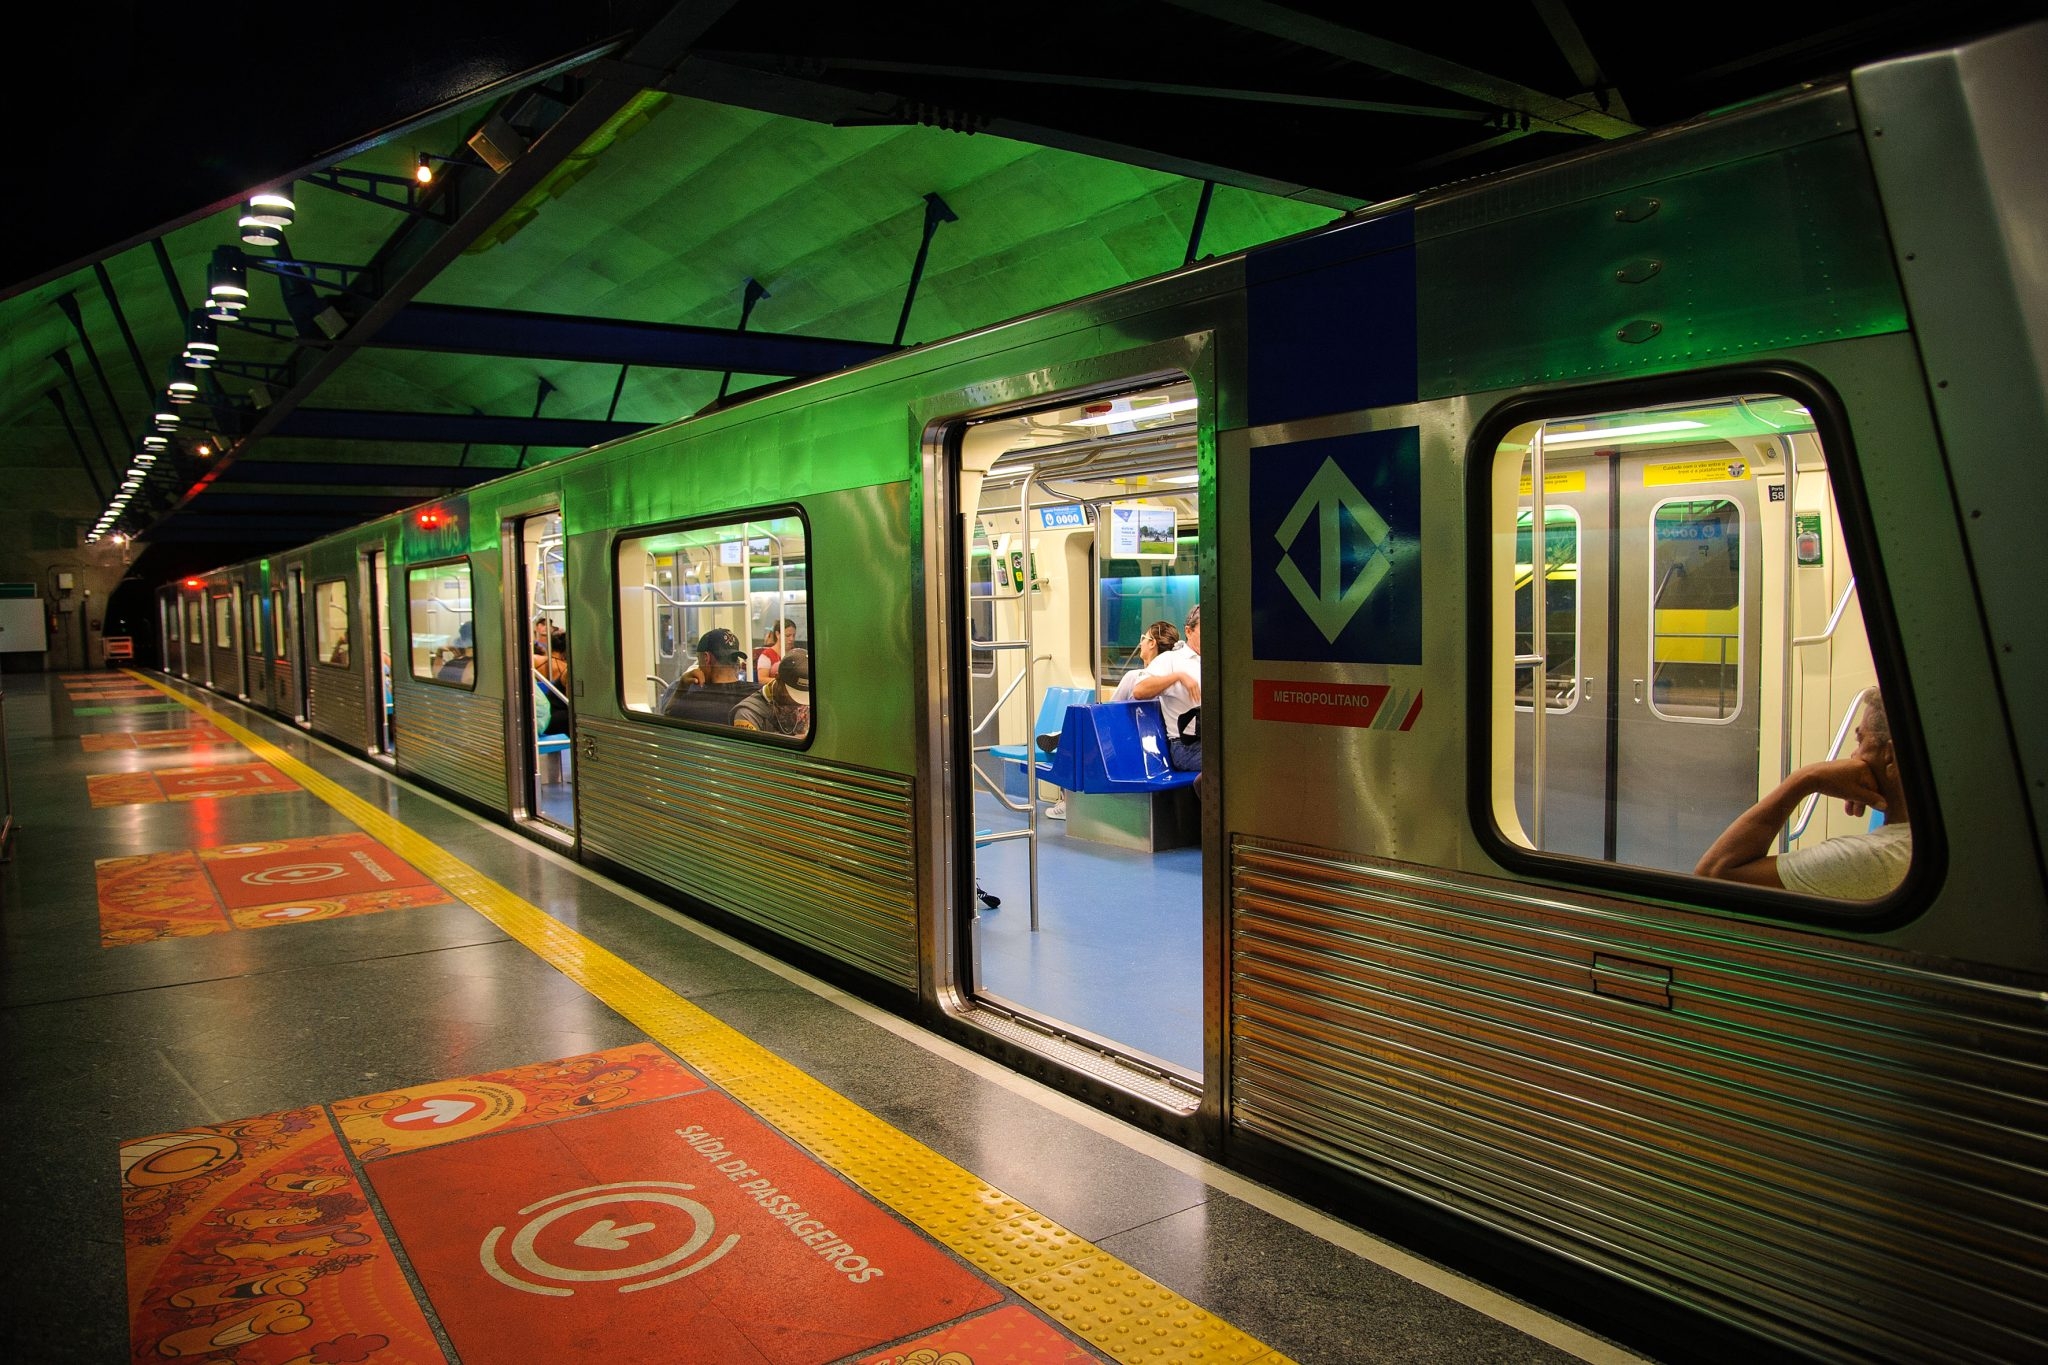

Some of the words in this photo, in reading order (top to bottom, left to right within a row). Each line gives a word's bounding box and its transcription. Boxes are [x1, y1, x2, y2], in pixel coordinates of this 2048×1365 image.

[1771, 492, 1784, 500] 58
[1274, 690, 1369, 708] METROPOLITANO
[675, 1125, 733, 1163] SAÍDA
[716, 1159, 758, 1182] DE
[739, 1178, 884, 1284] PASSAGEIROS
